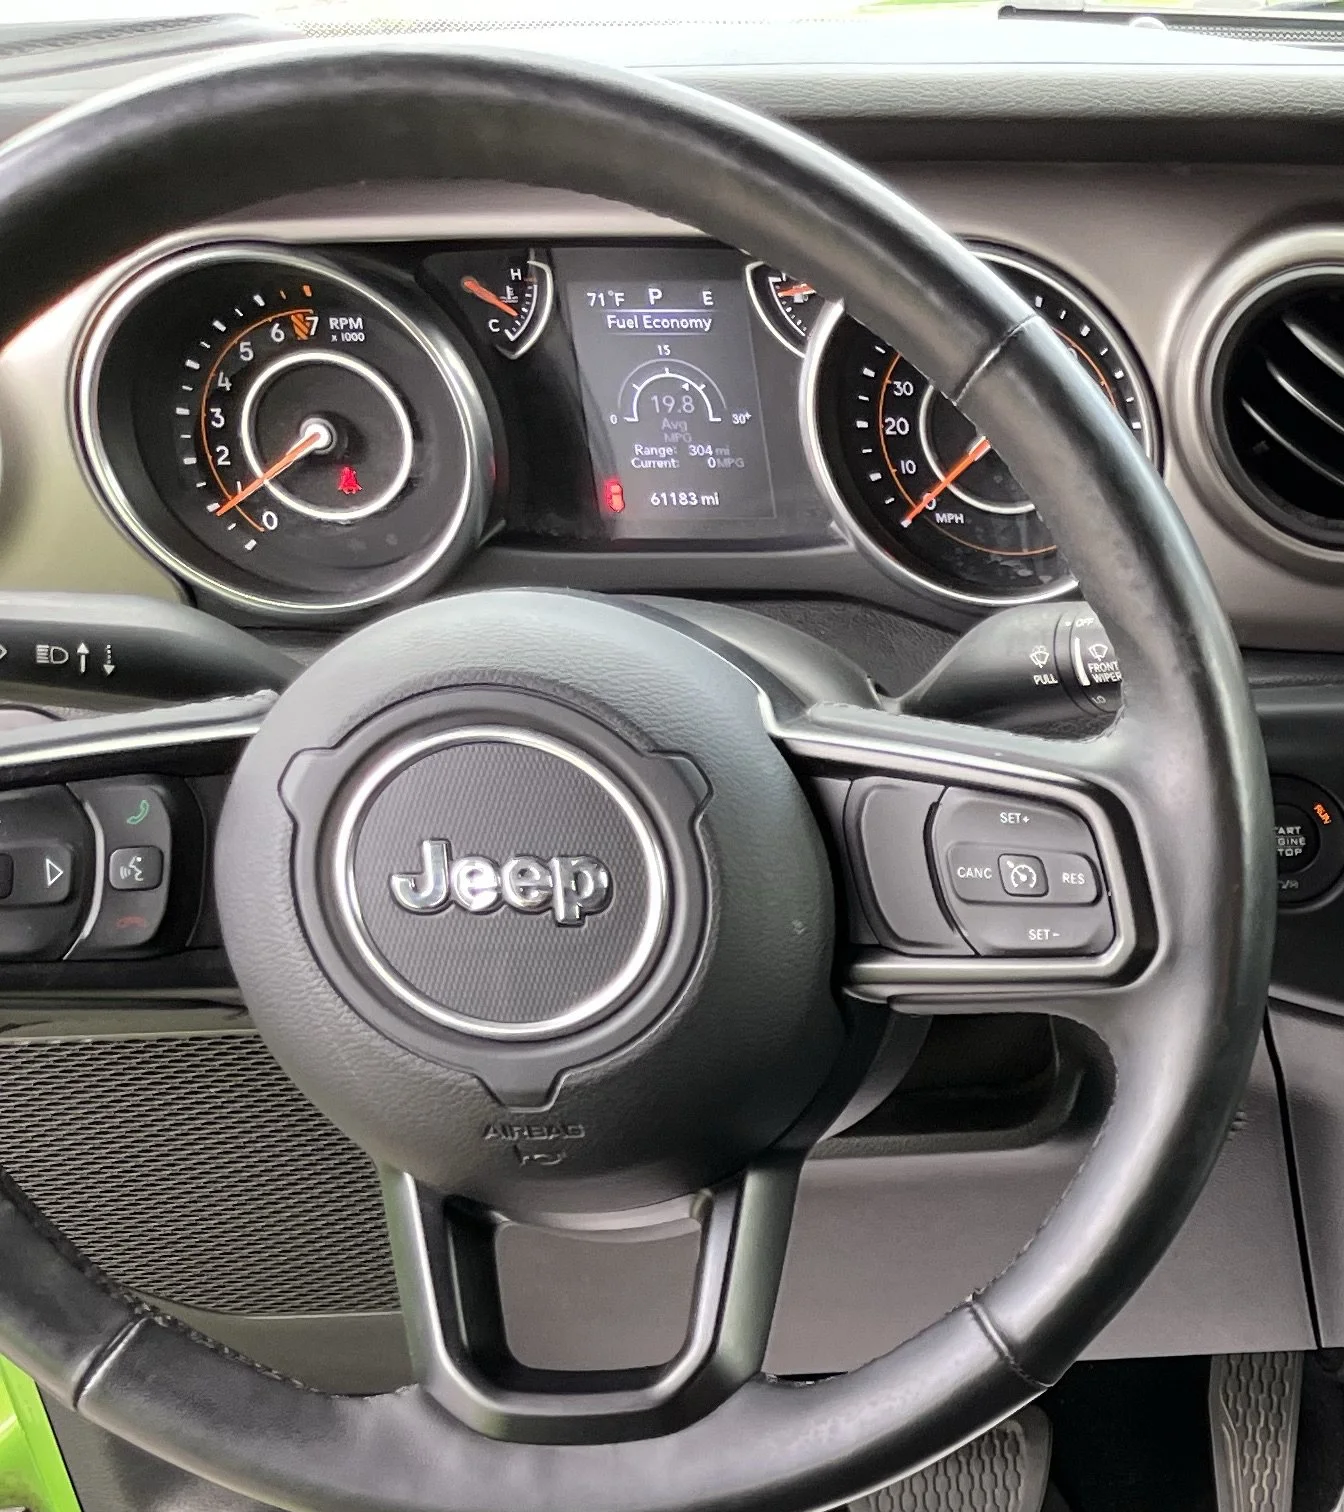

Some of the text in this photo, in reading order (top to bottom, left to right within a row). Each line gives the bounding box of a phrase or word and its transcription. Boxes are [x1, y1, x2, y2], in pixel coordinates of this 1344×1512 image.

[510, 268, 522, 281] H
[648, 287, 663, 306] P
[702, 290, 714, 306] E
[305, 316, 319, 336] 7
[329, 317, 364, 331] RPM
[488, 318, 501, 333] C
[606, 314, 713, 332] Fuel Economy
[270, 323, 285, 342] 6
[340, 332, 365, 343] 1000
[239, 341, 254, 362] 5
[656, 345, 671, 356] 15
[217, 372, 232, 391] 4
[892, 381, 914, 397] 30
[650, 394, 696, 414] 19.8
[210, 408, 225, 429] 3
[884, 418, 910, 435] 20
[215, 445, 231, 466] 2
[634, 443, 678, 458] Range:
[688, 444, 713, 457] 304
[631, 457, 680, 469] Current:
[707, 457, 716, 469] 0
[900, 459, 917, 475] 10
[650, 491, 720, 506] 61183 mi
[261, 511, 278, 531] 0
[934, 511, 965, 525] MPH
[1075, 617, 1095, 628] OFF
[1087, 661, 1120, 674] FRONT
[1033, 673, 1059, 686] PULL
[1091, 671, 1123, 684] WIPER
[1277, 836, 1306, 846] GINE
[1277, 847, 1303, 857] TOP
[956, 866, 993, 880] CANC
[1062, 871, 1086, 885] RES
[389, 837, 615, 928] Jeep
[482, 1122, 586, 1141] AIRBAG
